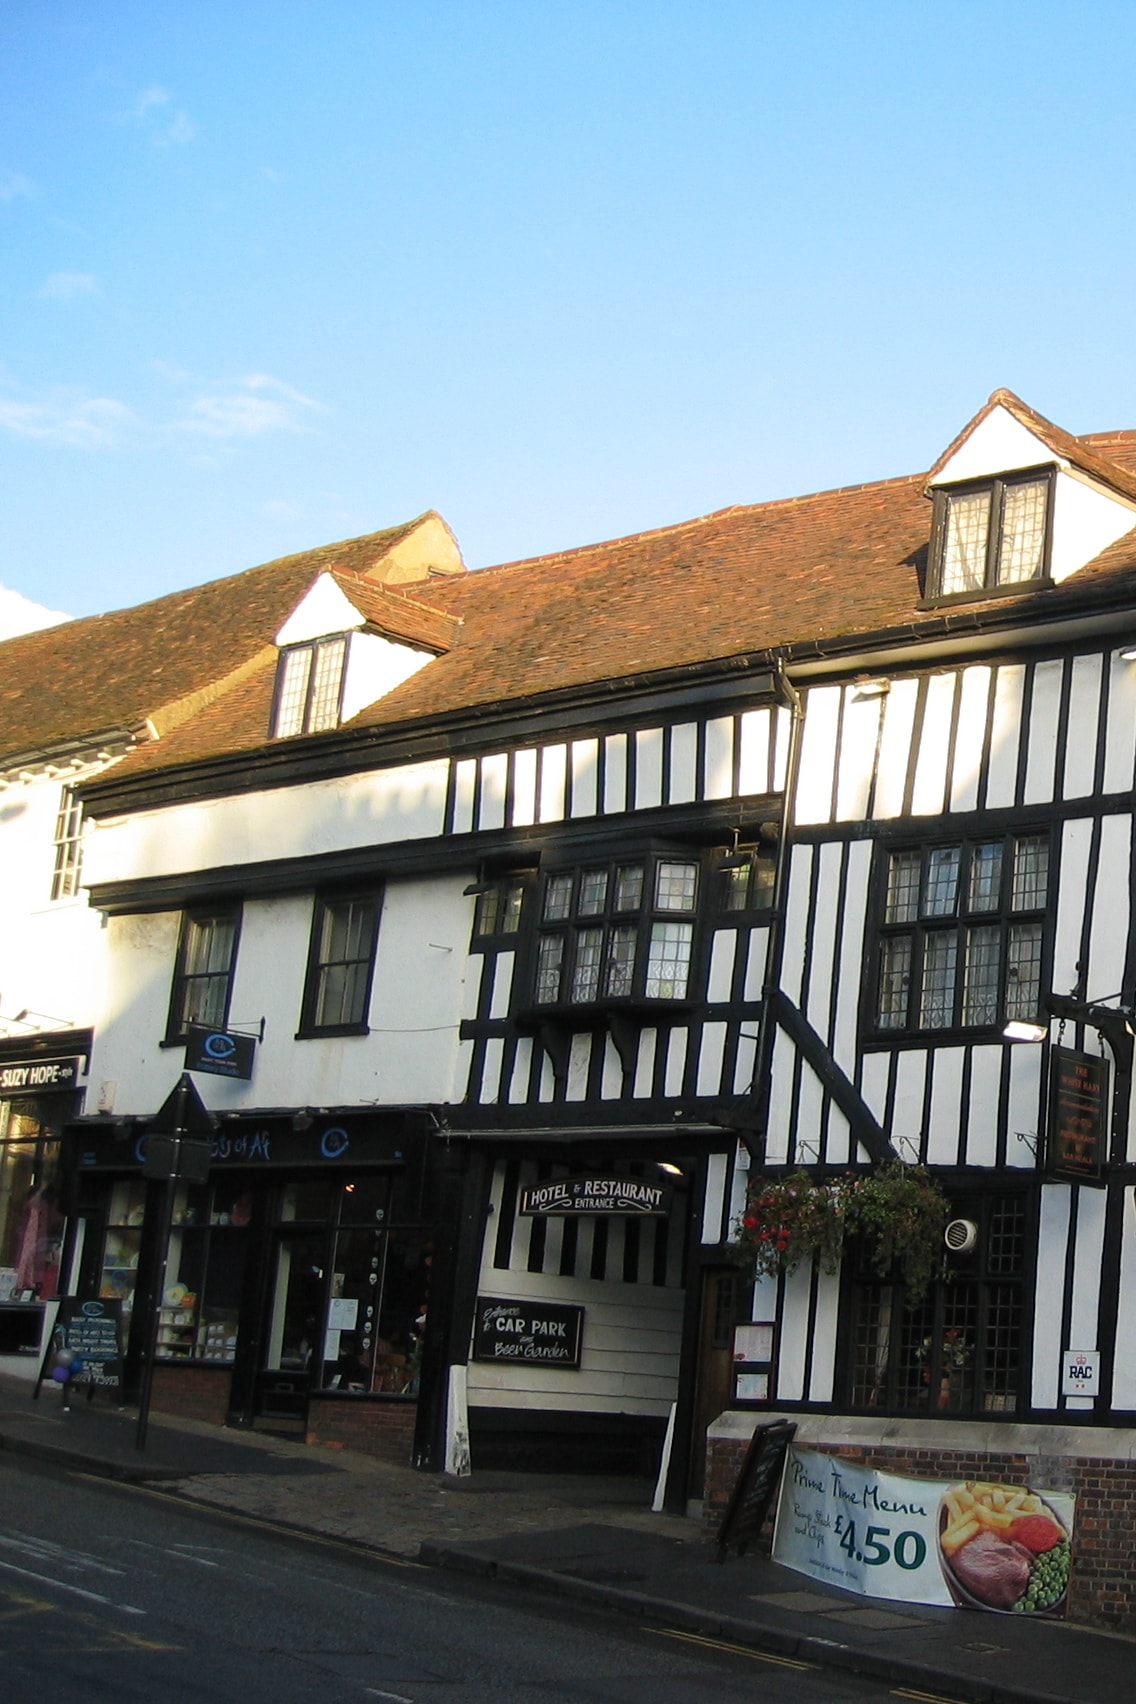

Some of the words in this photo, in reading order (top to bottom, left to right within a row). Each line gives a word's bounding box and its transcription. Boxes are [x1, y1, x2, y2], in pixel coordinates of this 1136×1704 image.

[1, 1067, 29, 1087] SUZY
[30, 1065, 60, 1084] HOPE
[530, 1184, 569, 1206] HOTEL
[573, 1184, 582, 1194] &
[584, 1181, 663, 1205] RESTAURANT
[574, 1198, 615, 1209] ENTRANCE
[495, 1317, 526, 1333] CAR
[531, 1320, 567, 1337] PARK
[494, 1342, 523, 1357] Beer
[524, 1341, 569, 1358] Garden
[1069, 1366, 1093, 1379] RAC
[791, 1460, 825, 1493] Prime
[831, 1472, 859, 1504] Time
[863, 1485, 928, 1516] Menu
[833, 1515, 927, 1570] £4.50
